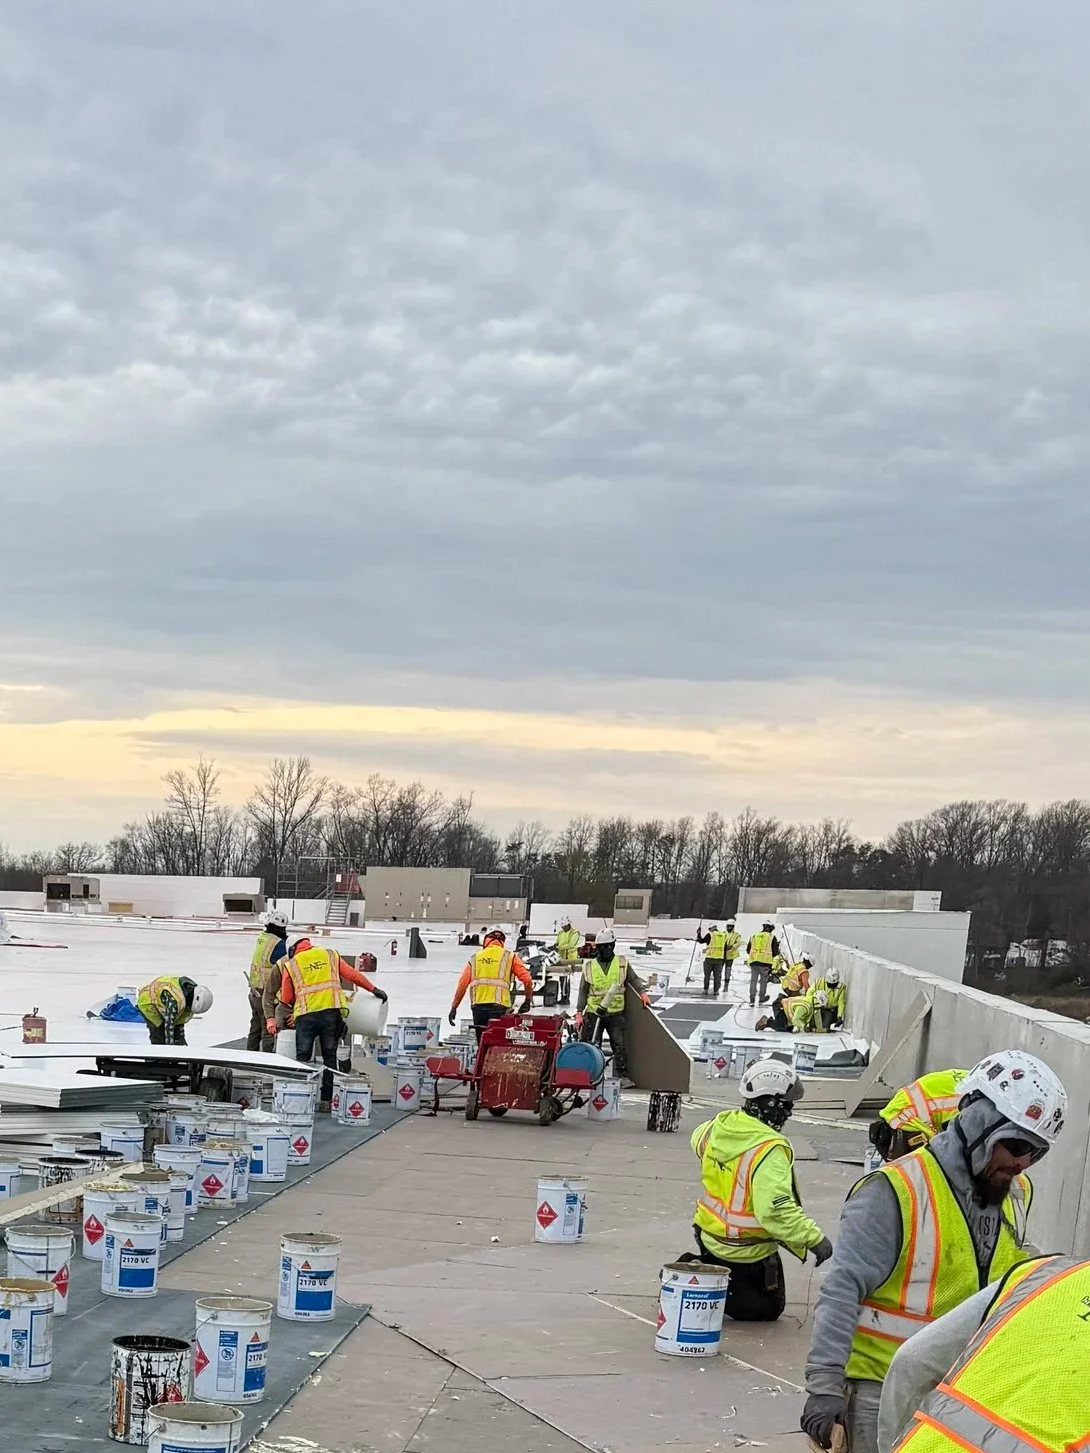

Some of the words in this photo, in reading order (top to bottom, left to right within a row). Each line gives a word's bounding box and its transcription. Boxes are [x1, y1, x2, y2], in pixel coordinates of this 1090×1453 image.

[140, 1256, 150, 1264] VC
[684, 1300, 708, 1311] 2170
[248, 1353, 263, 1362] 2170
